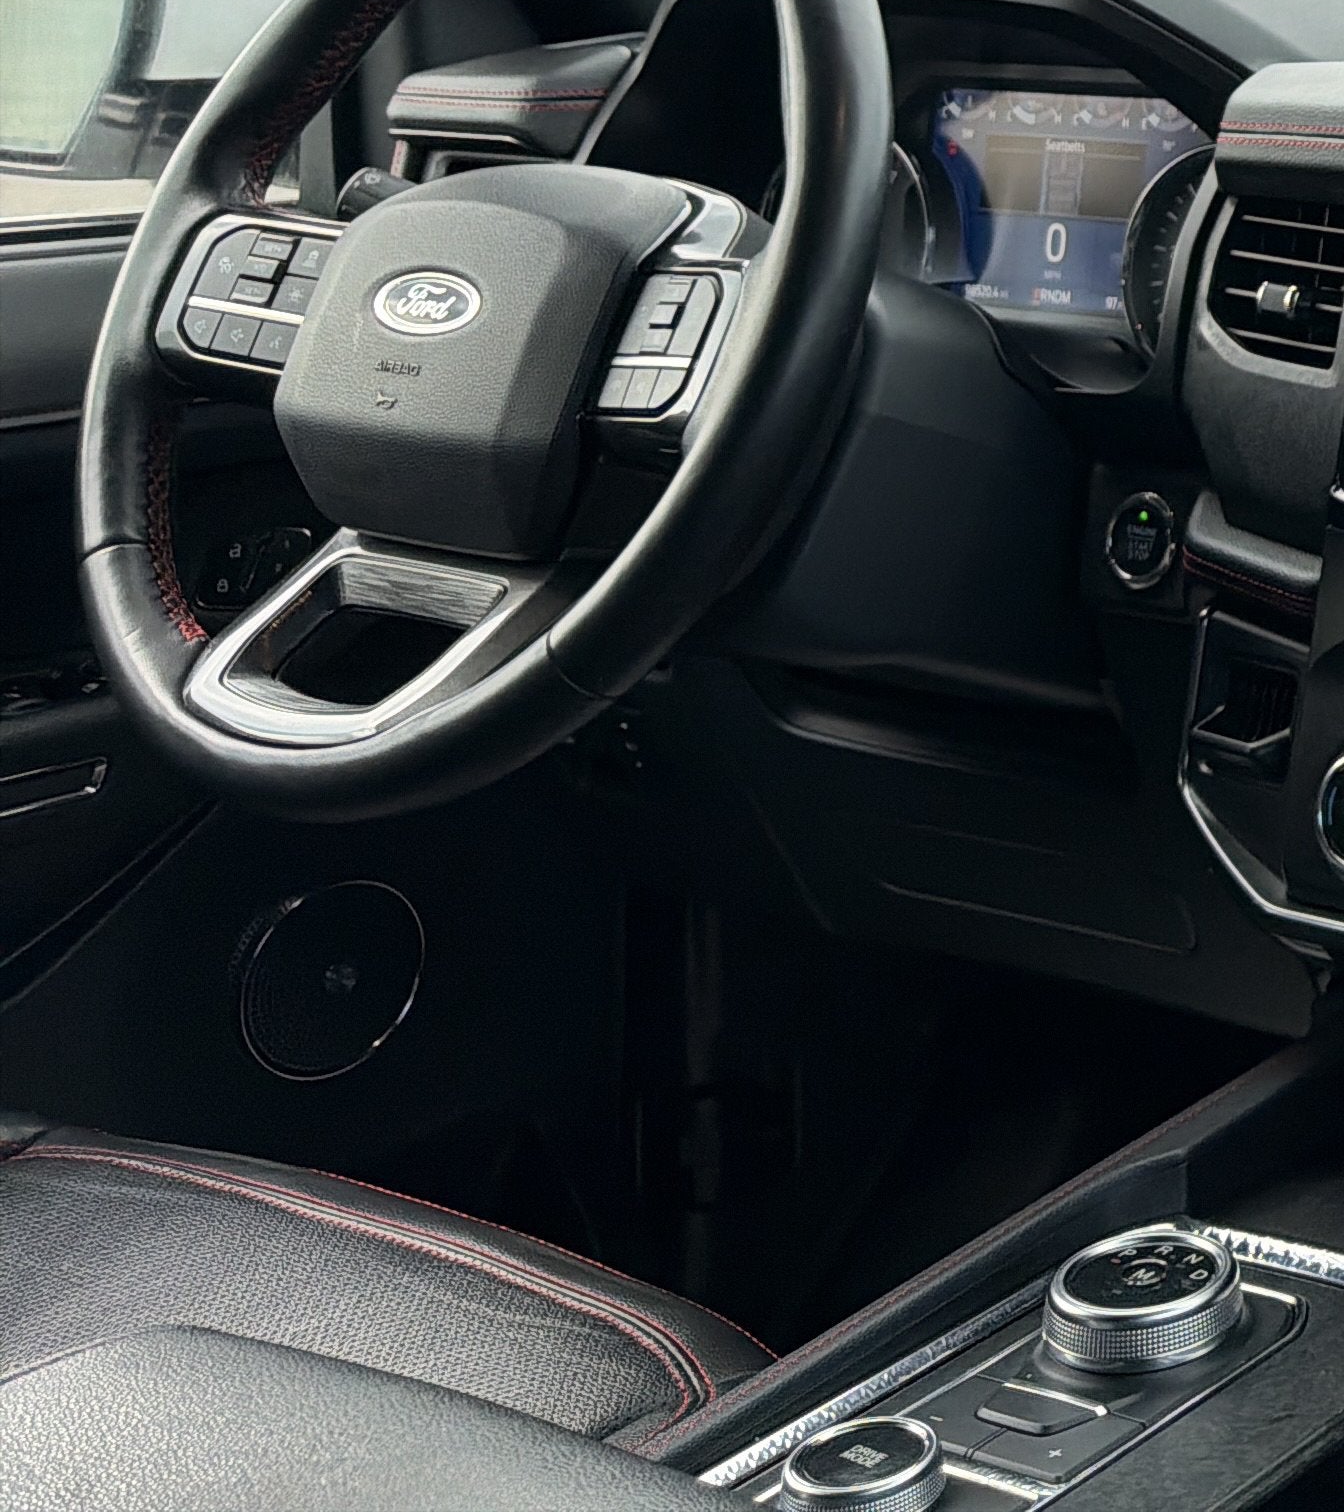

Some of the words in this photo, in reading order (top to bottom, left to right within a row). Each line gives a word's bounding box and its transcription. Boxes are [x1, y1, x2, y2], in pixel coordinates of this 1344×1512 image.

[1045, 138, 1086, 154] Seatbelts
[1045, 222, 1067, 263] 0
[397, 283, 456, 320] Ford
[1118, 1248, 1137, 1257] P
[1154, 1245, 1174, 1255] R
[1183, 1253, 1204, 1264] N
[1130, 1268, 1156, 1281] M
[1189, 1269, 1208, 1279] D
[850, 1444, 889, 1460] DRIVE
[839, 1452, 874, 1469] MODE
